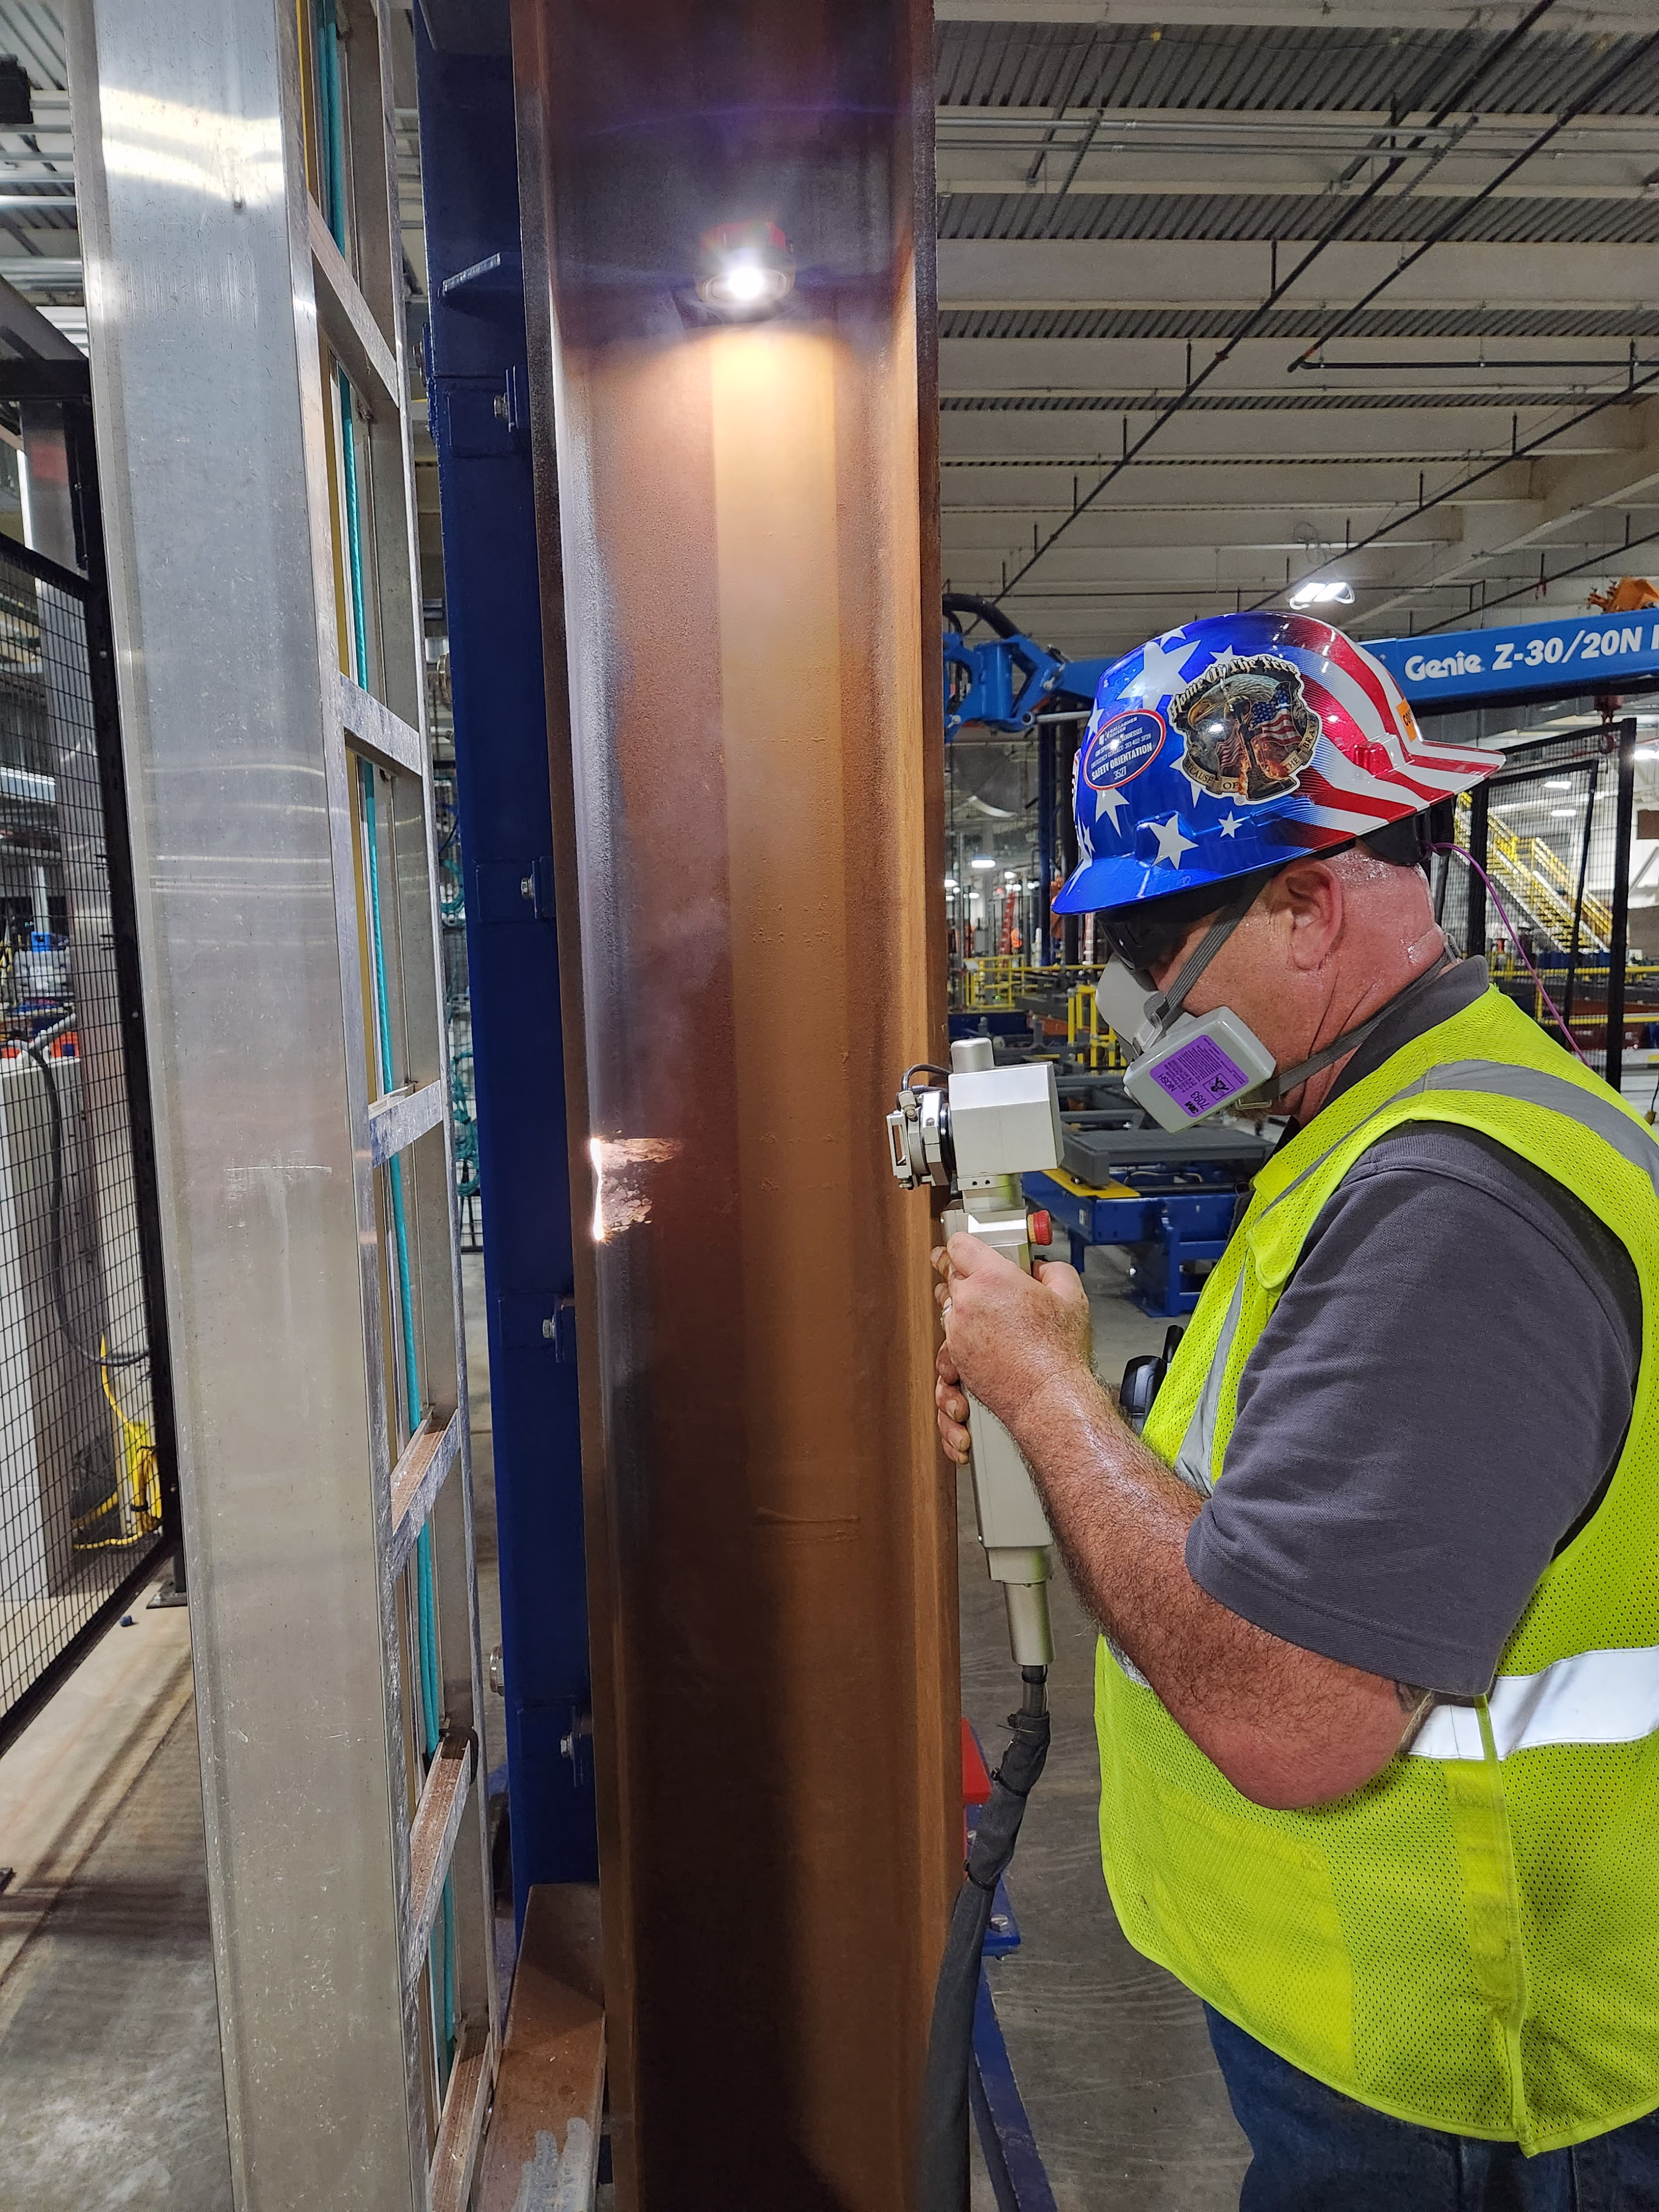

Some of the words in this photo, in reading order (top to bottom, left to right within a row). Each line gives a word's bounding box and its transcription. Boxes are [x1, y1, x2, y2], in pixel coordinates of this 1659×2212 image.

[1405, 650, 1481, 681] Genie
[1492, 626, 1643, 671] Z-30/20N
[1171, 679, 1205, 718] Home
[1229, 657, 1258, 674] The
[1259, 655, 1298, 676] Free
[1092, 763, 1110, 781] SAFETY
[1110, 742, 1152, 769] ORIENTATION
[1185, 761, 1213, 784] BECAUSE
[1223, 781, 1239, 790] OF
[1283, 757, 1300, 772] THE
[1157, 1073, 1177, 1092] NIOSH
[1185, 1101, 1199, 1114] 3M
[1190, 1091, 1210, 1110] 7093
